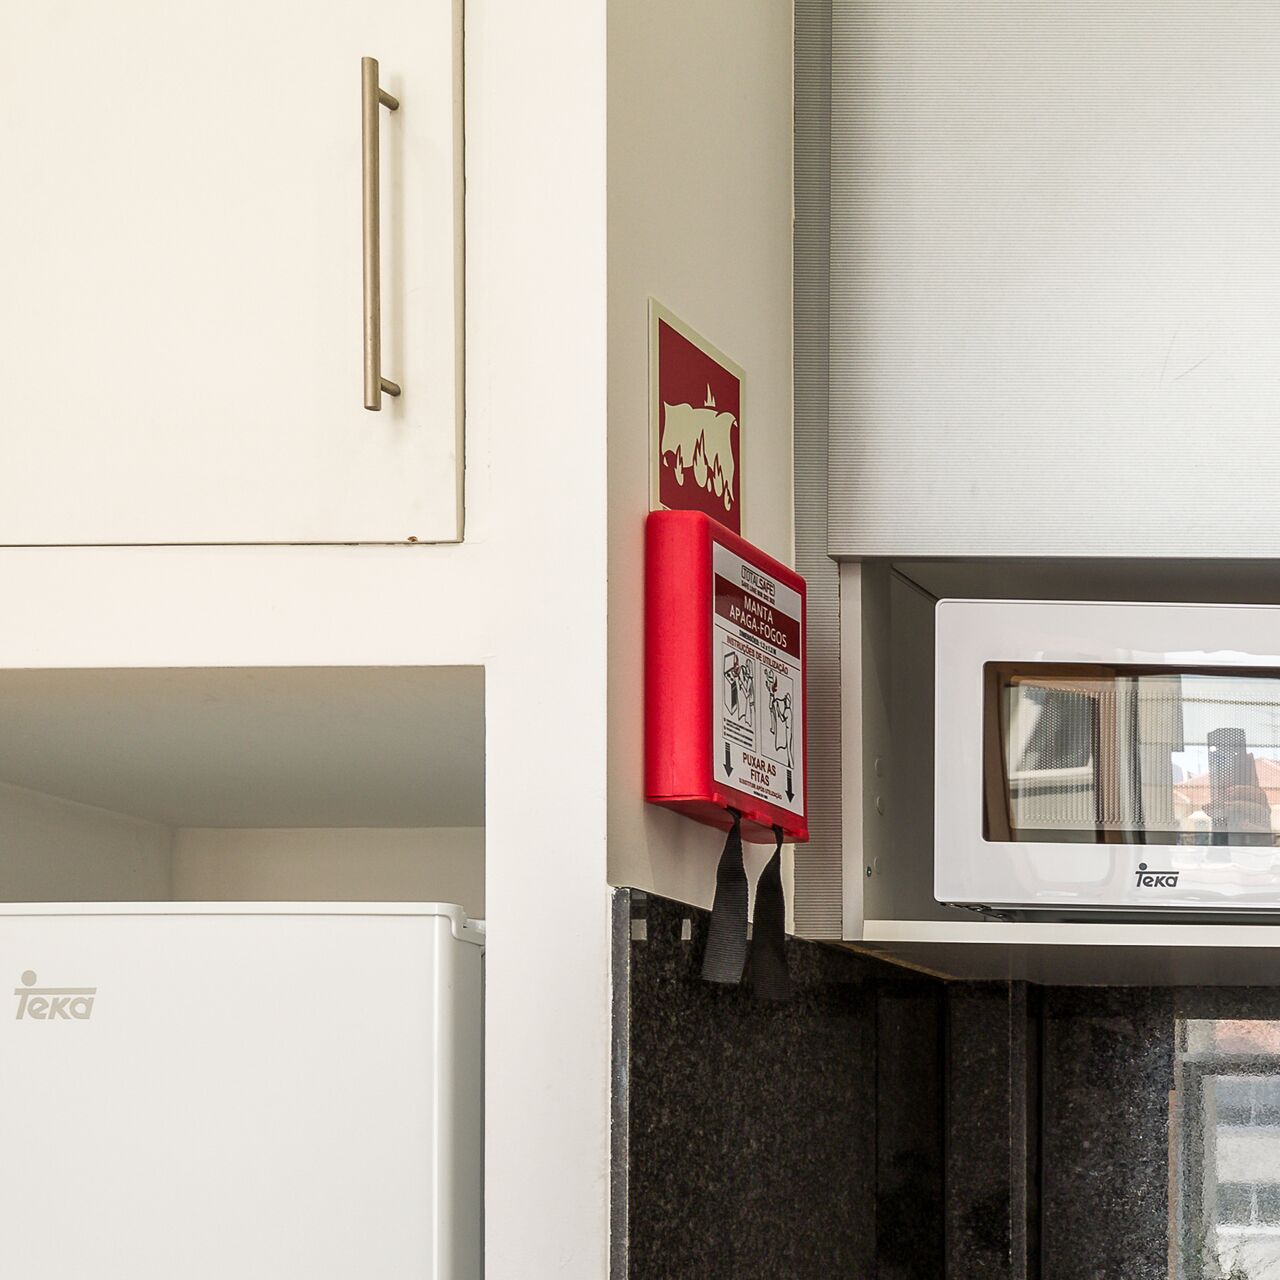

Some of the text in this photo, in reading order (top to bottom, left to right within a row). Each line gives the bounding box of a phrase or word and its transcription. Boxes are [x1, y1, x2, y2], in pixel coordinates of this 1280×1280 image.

[742, 566, 774, 596] TOTALSAFE
[744, 596, 774, 624] MANTA
[729, 604, 787, 648] APAGA-FOGOS
[727, 635, 789, 675] INSTRUÇÕES DE UTILIZAÇÃO
[742, 752, 777, 777] PUXAR AS
[750, 769, 770, 787] FITAS
[1135, 863, 1179, 887] Teka
[14, 970, 97, 1020] Teka
